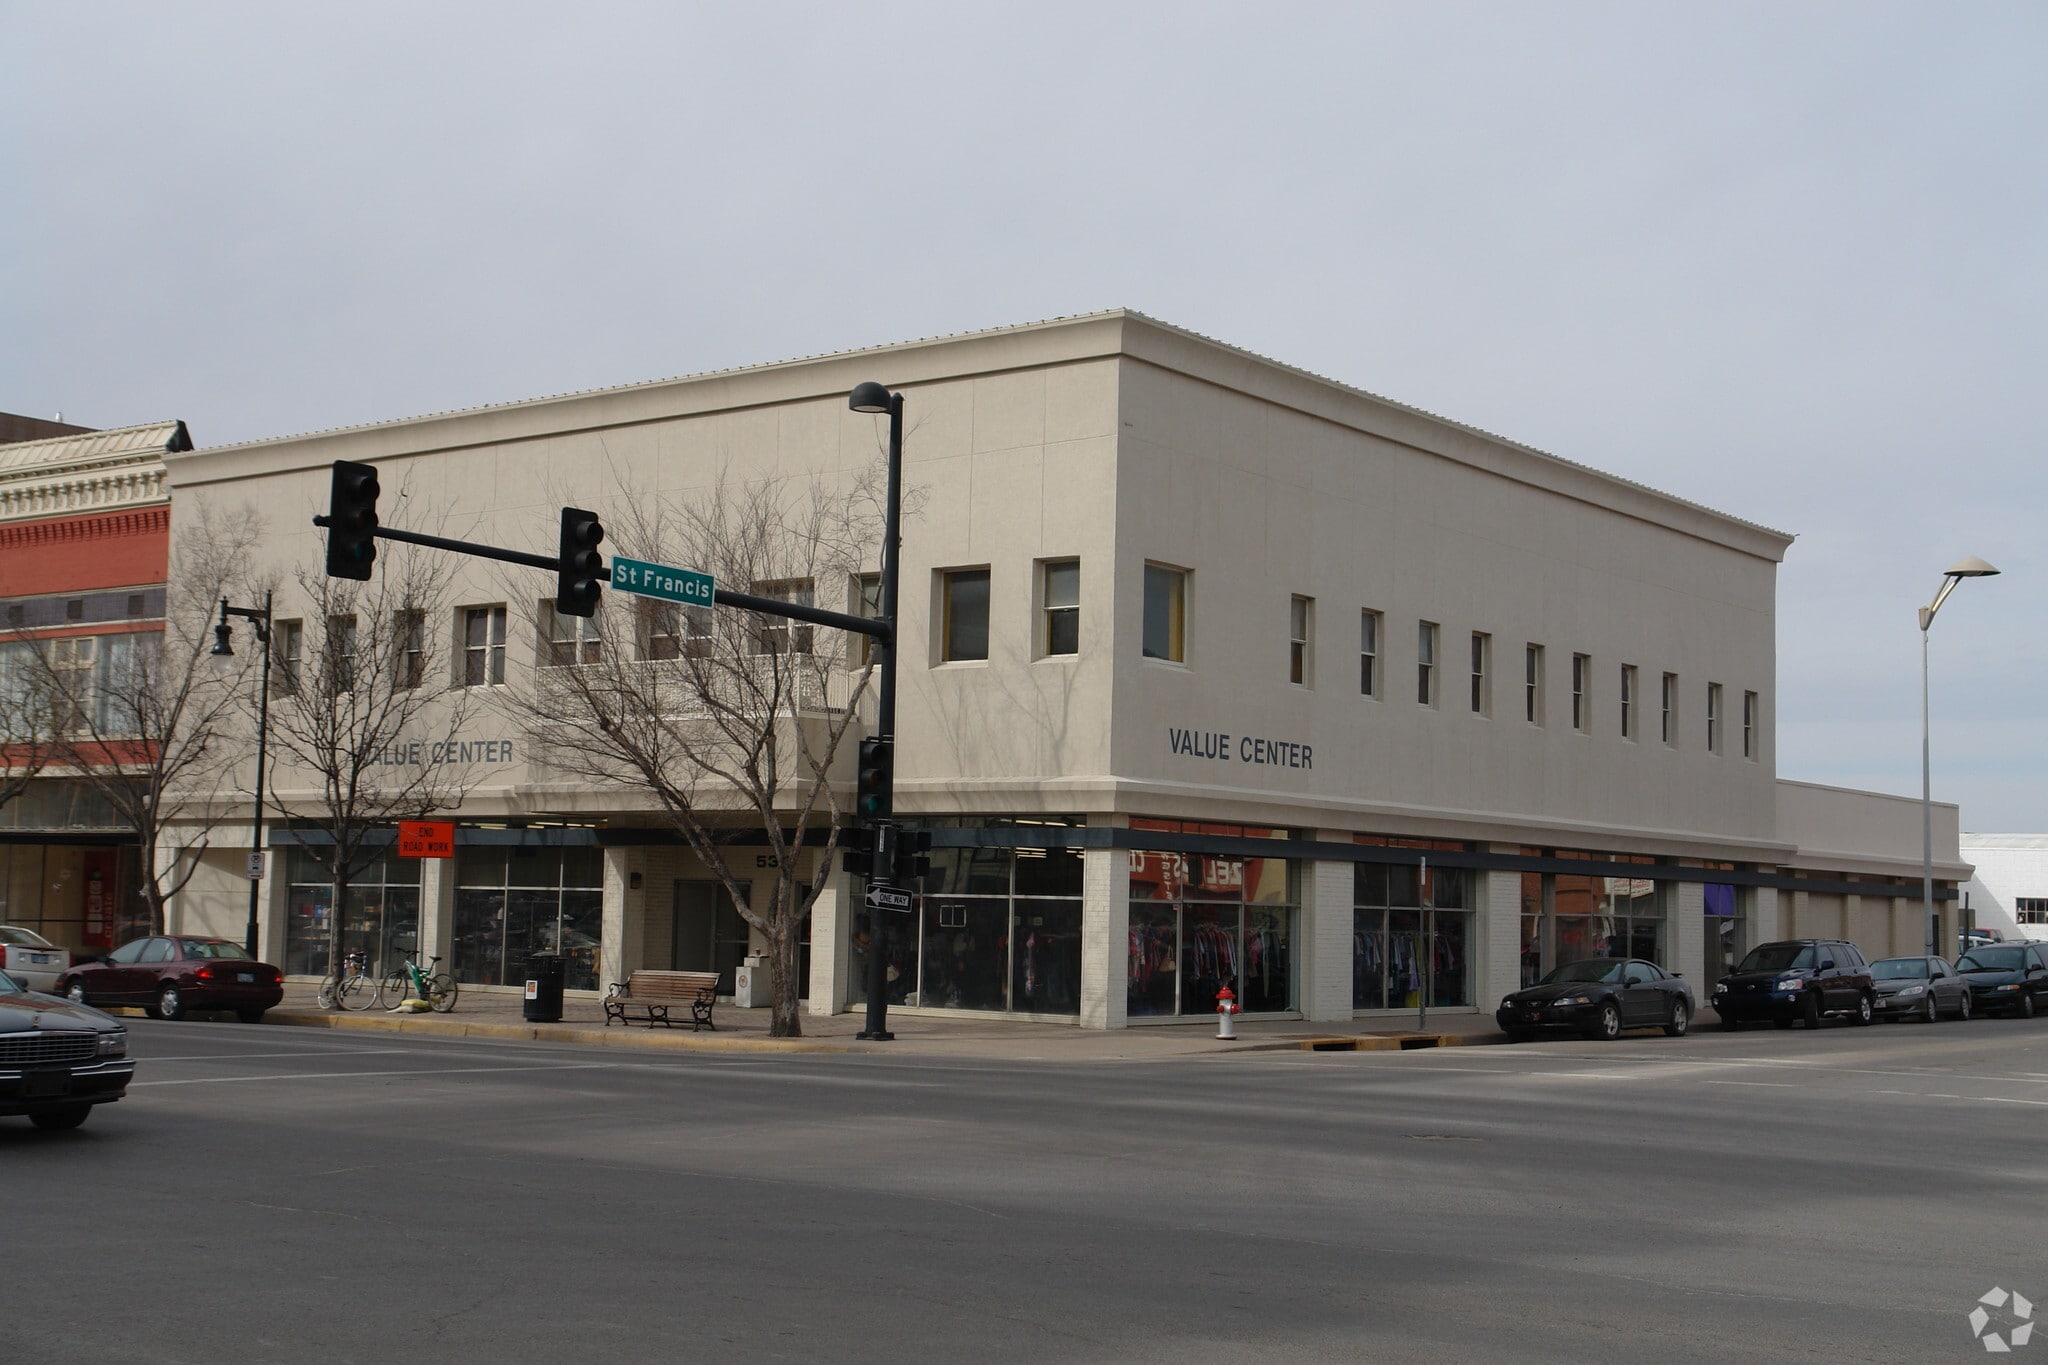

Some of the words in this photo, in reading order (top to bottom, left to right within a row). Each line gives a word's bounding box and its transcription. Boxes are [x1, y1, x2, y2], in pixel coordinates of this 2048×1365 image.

[616, 564, 637, 584] St
[643, 569, 710, 598] Francis
[431, 740, 513, 765] CENTER
[1169, 727, 1230, 761] VALUE
[1240, 736, 1313, 769] CENTER
[419, 826, 434, 838] END
[403, 841, 423, 852] ROAD
[428, 842, 449, 852] WORK
[756, 855, 789, 868] 53
[880, 893, 893, 903] ONE
[893, 895, 908, 905] WAY
